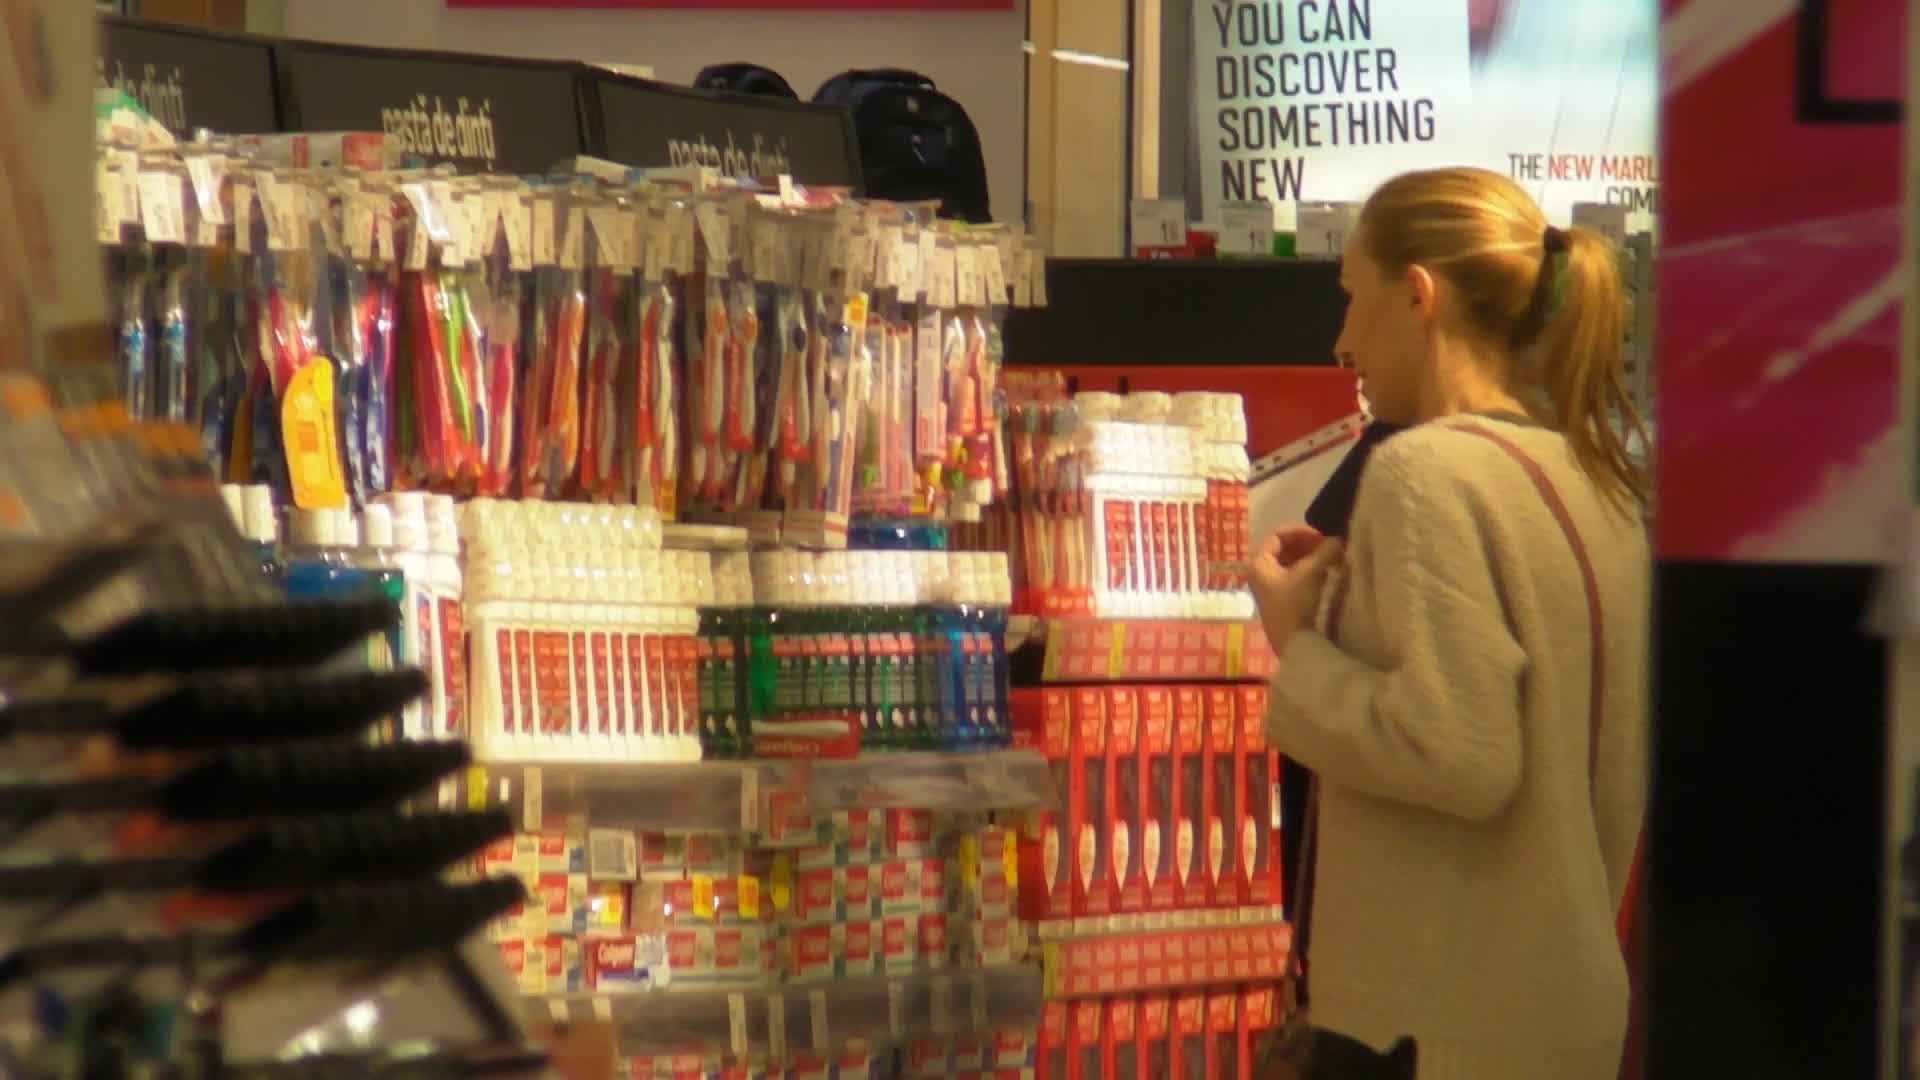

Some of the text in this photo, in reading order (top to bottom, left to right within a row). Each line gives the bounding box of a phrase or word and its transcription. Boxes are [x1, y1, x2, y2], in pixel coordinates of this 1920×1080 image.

[1212, 0, 1371, 48] YOU CAN
[1215, 48, 1399, 99] DISCOVER
[1218, 98, 1435, 151] SOMETHING
[1221, 156, 1305, 201] NEW
[1508, 152, 1544, 181] THE
[1547, 153, 1593, 182] NEW
